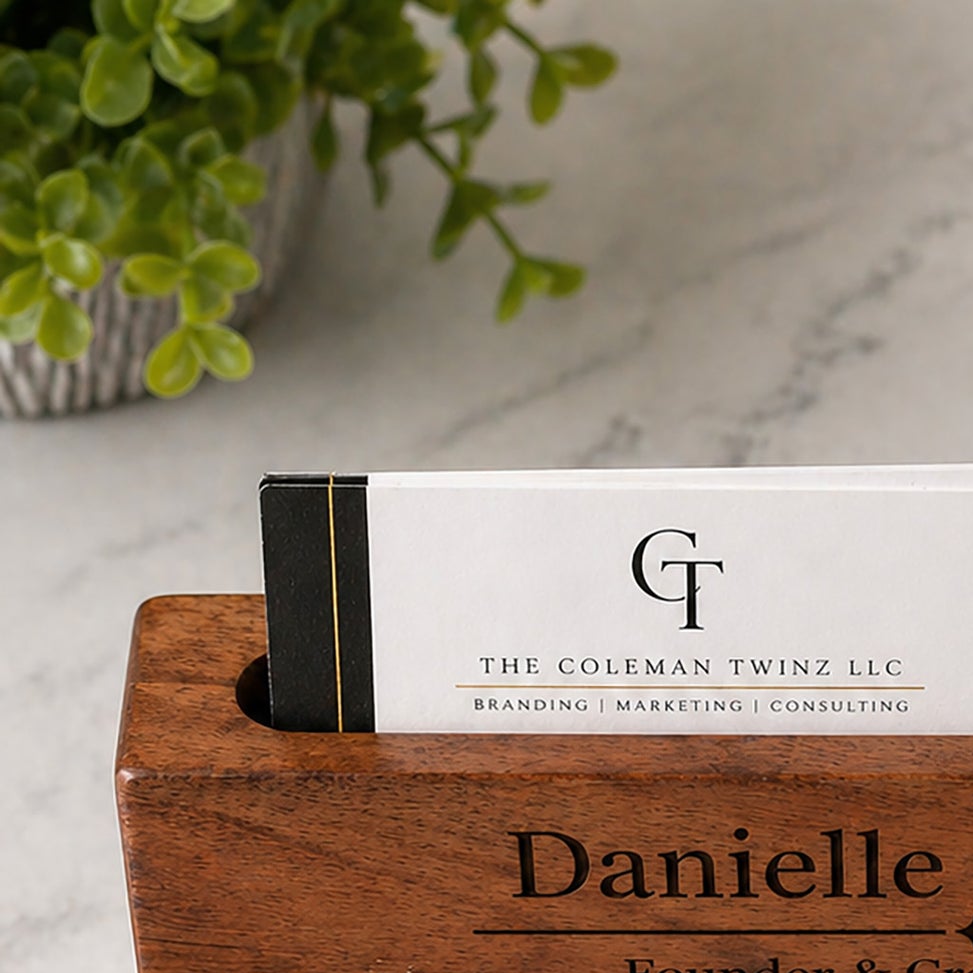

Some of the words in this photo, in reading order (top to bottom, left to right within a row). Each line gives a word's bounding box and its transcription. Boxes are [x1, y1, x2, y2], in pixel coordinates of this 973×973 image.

[479, 657, 540, 675] THE
[558, 657, 711, 676] COLEMAN
[729, 658, 831, 676] TWINZ
[849, 659, 903, 677] LLC
[474, 698, 588, 712] BRANDING
[616, 699, 742, 713] MARKETING
[770, 700, 909, 714] CONSULTING
[509, 827, 944, 900] Danielle
